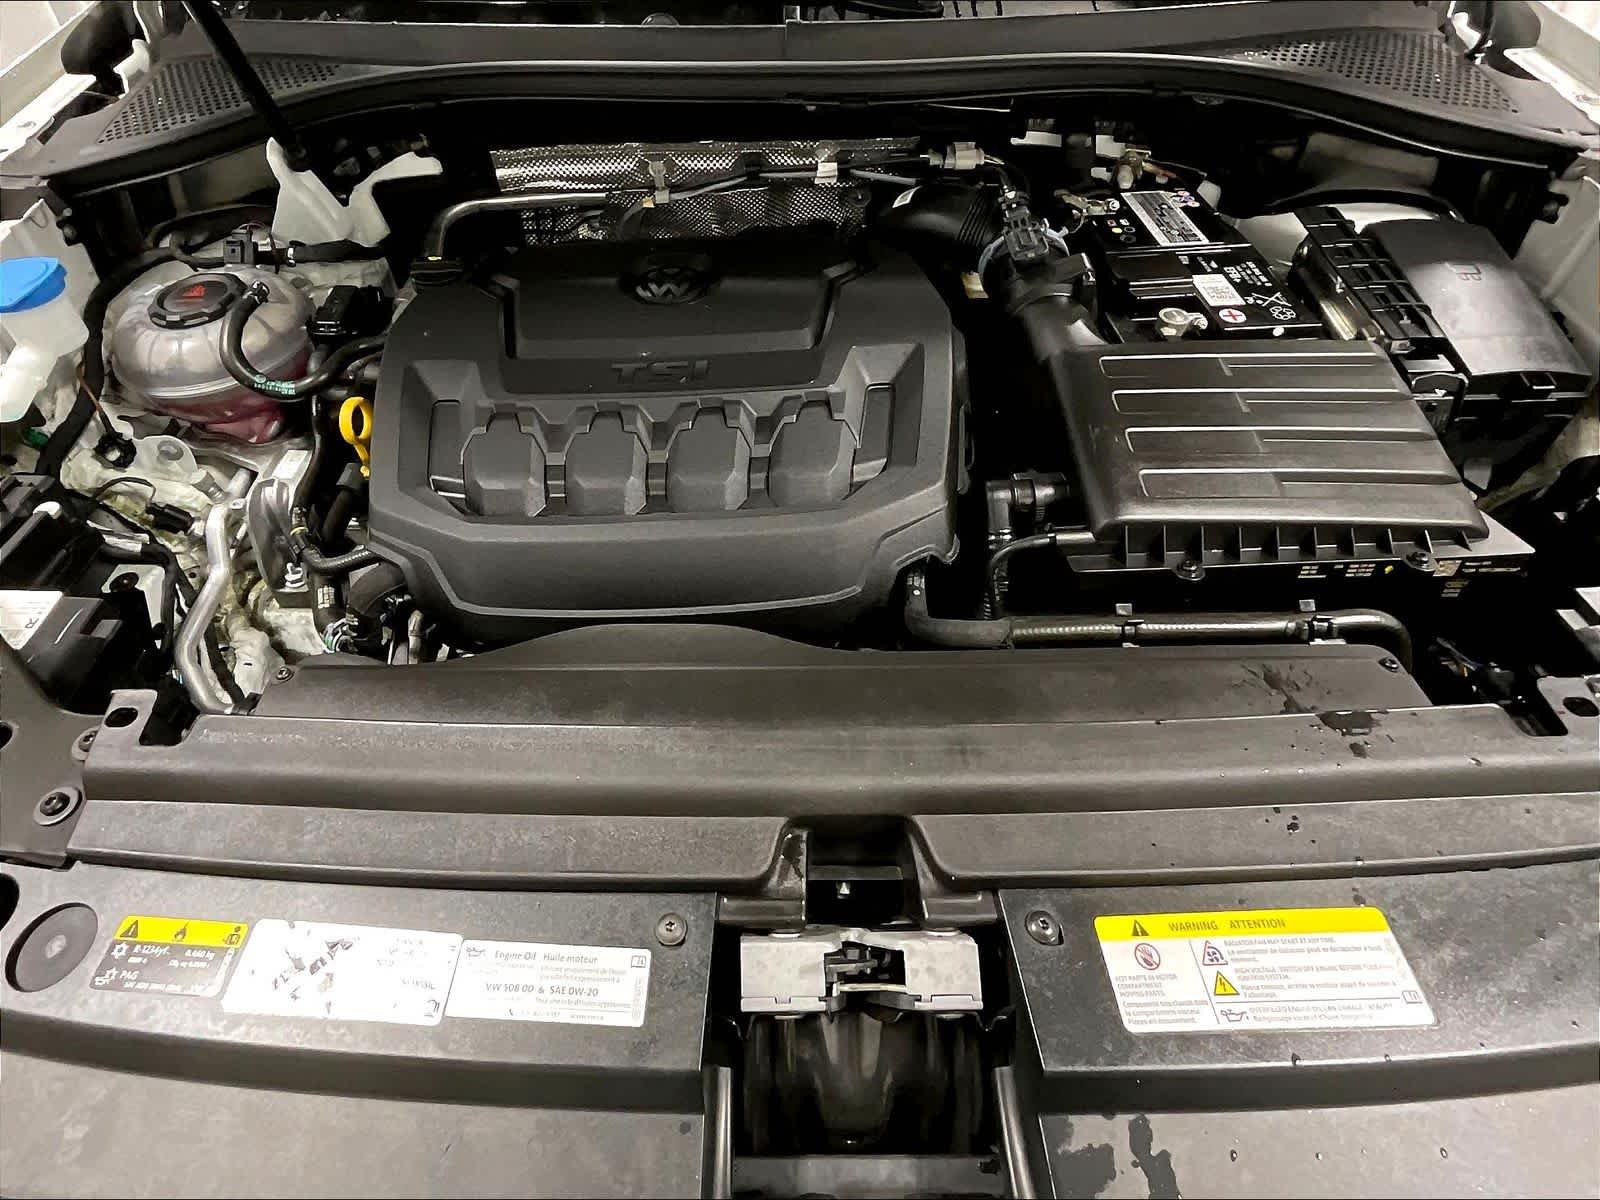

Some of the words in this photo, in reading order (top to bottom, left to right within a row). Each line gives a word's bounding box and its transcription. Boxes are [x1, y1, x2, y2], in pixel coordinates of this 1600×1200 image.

[610, 360, 709, 384] TSI
[1168, 920, 1219, 932] WARNING
[1229, 918, 1286, 930] ATTENTION
[495, 950, 522, 960] Engine
[523, 951, 536, 960] Oil
[543, 952, 565, 962] Huile
[566, 954, 598, 964] moteur
[486, 983, 502, 991] VW
[504, 983, 520, 993] 508
[522, 984, 535, 993] 00
[537, 985, 545, 994] &
[550, 985, 567, 995] SAE
[568, 986, 599, 997] 0W-20
